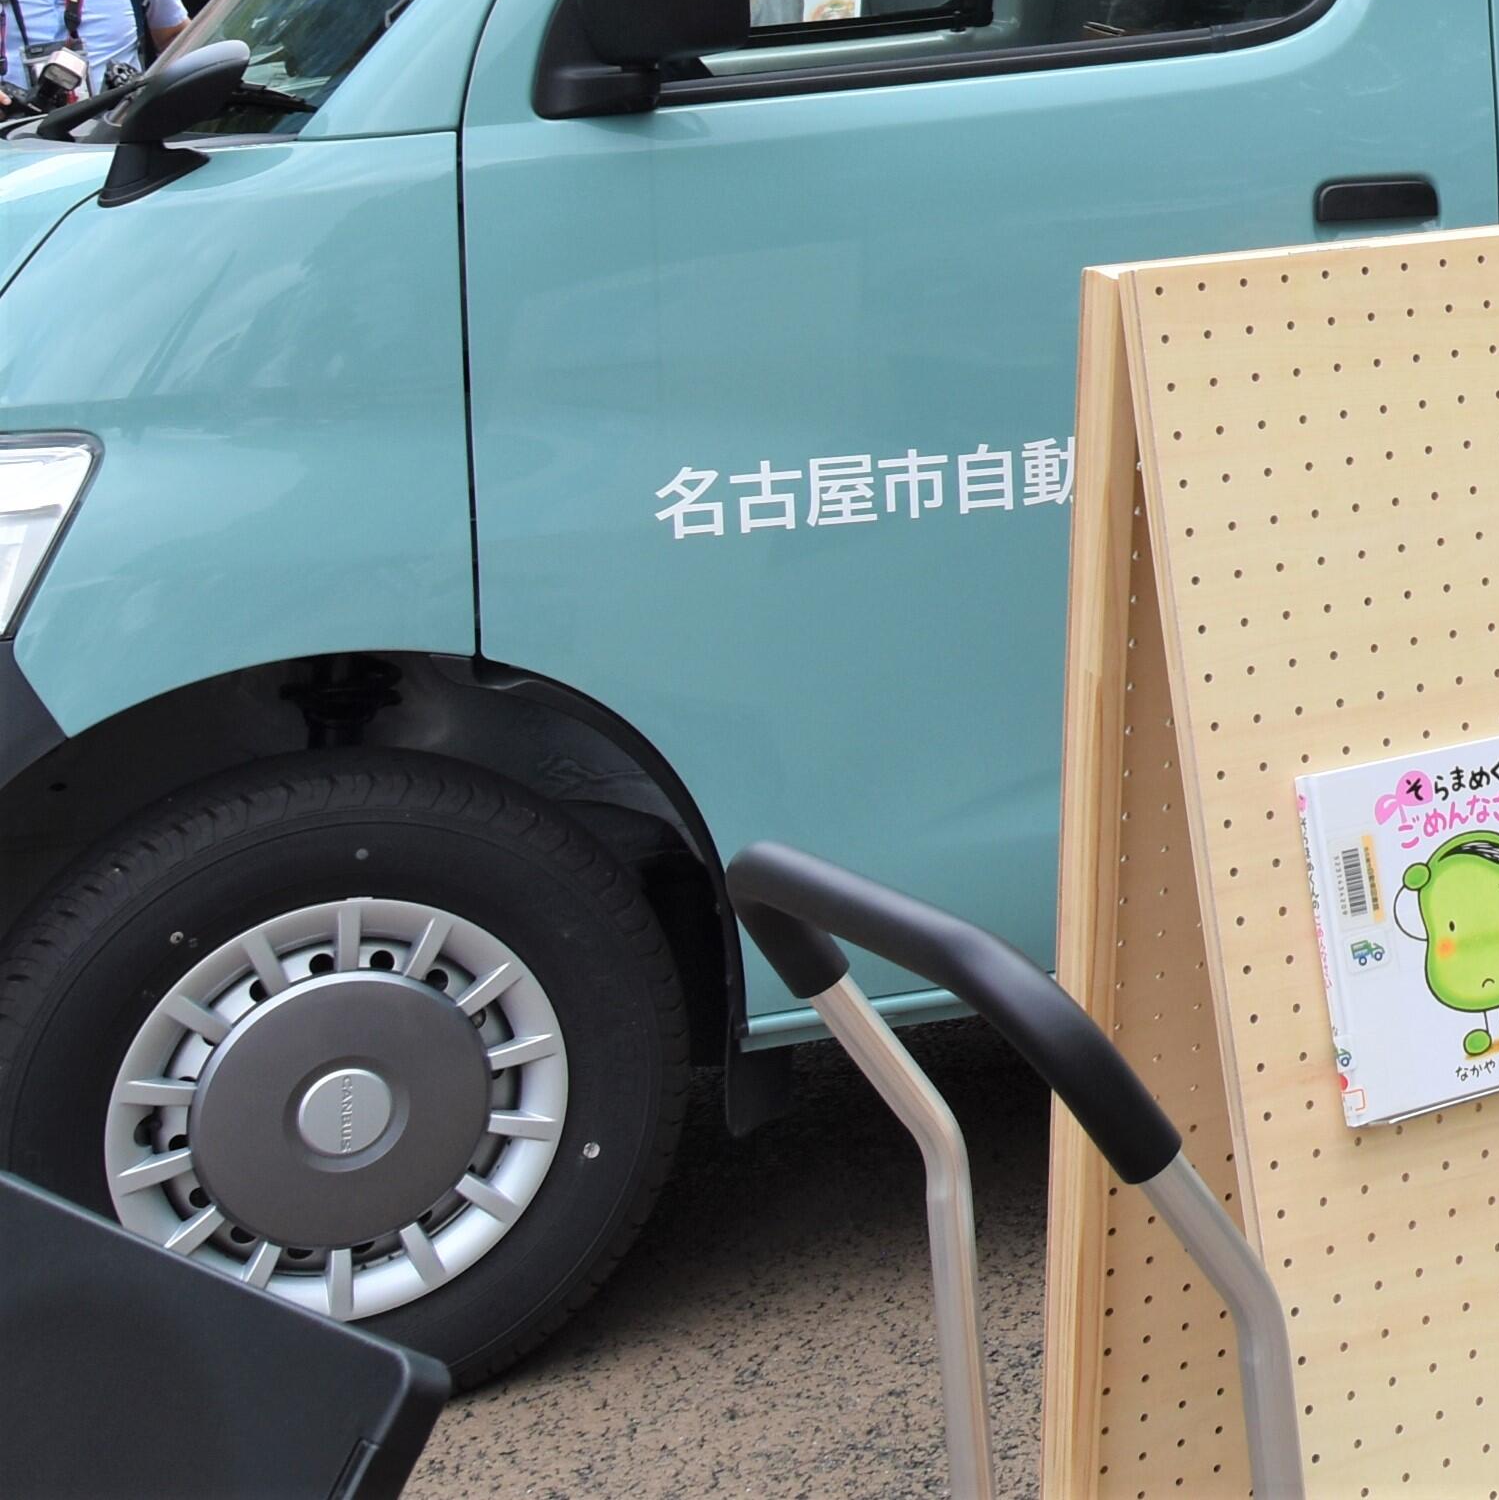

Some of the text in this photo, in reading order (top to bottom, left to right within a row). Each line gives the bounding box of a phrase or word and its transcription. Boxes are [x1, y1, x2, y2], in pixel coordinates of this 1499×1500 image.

[655, 436, 1075, 540] 名古屋市自動
[1455, 1059, 1496, 1081] なかや
